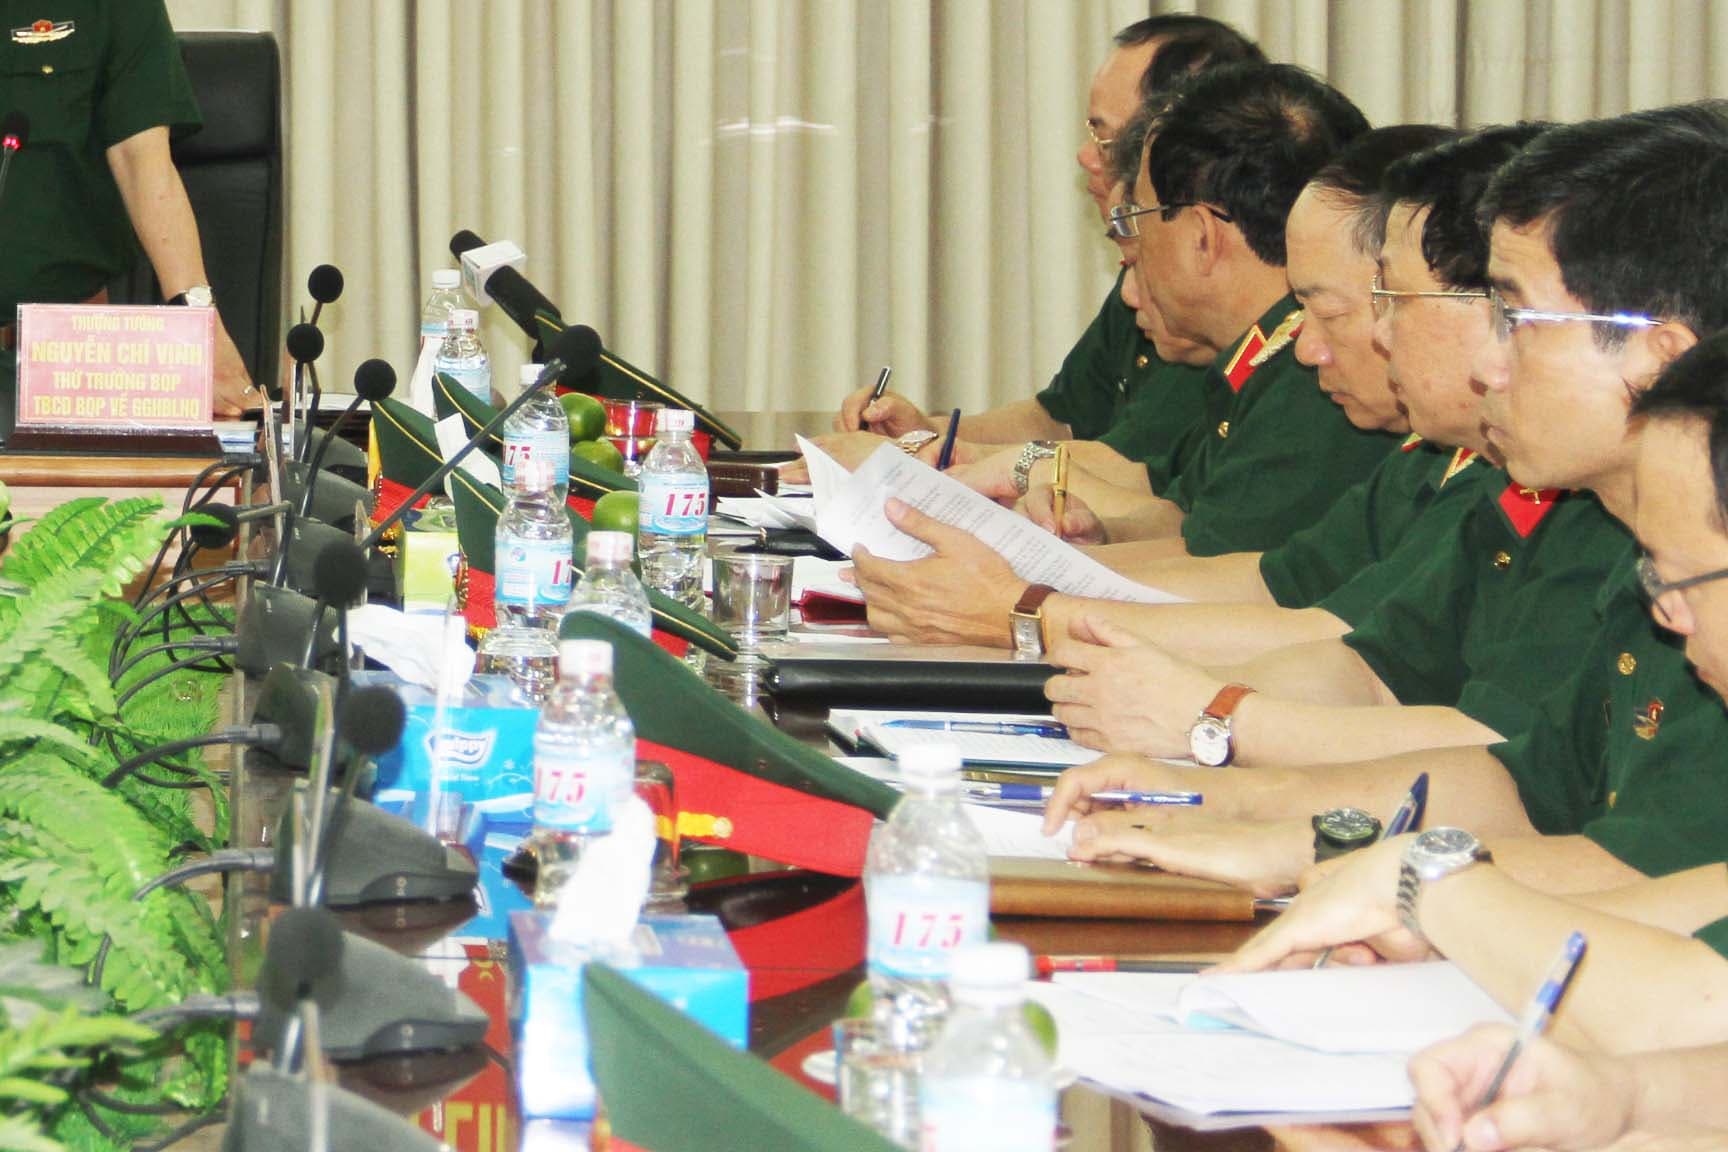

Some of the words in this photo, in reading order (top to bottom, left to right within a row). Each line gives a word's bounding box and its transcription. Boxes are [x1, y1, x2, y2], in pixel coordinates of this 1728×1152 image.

[32, 335, 112, 364] NGUYỄN
[116, 338, 149, 365] CHÍ
[664, 492, 705, 516] 175
[893, 911, 963, 948] 175
